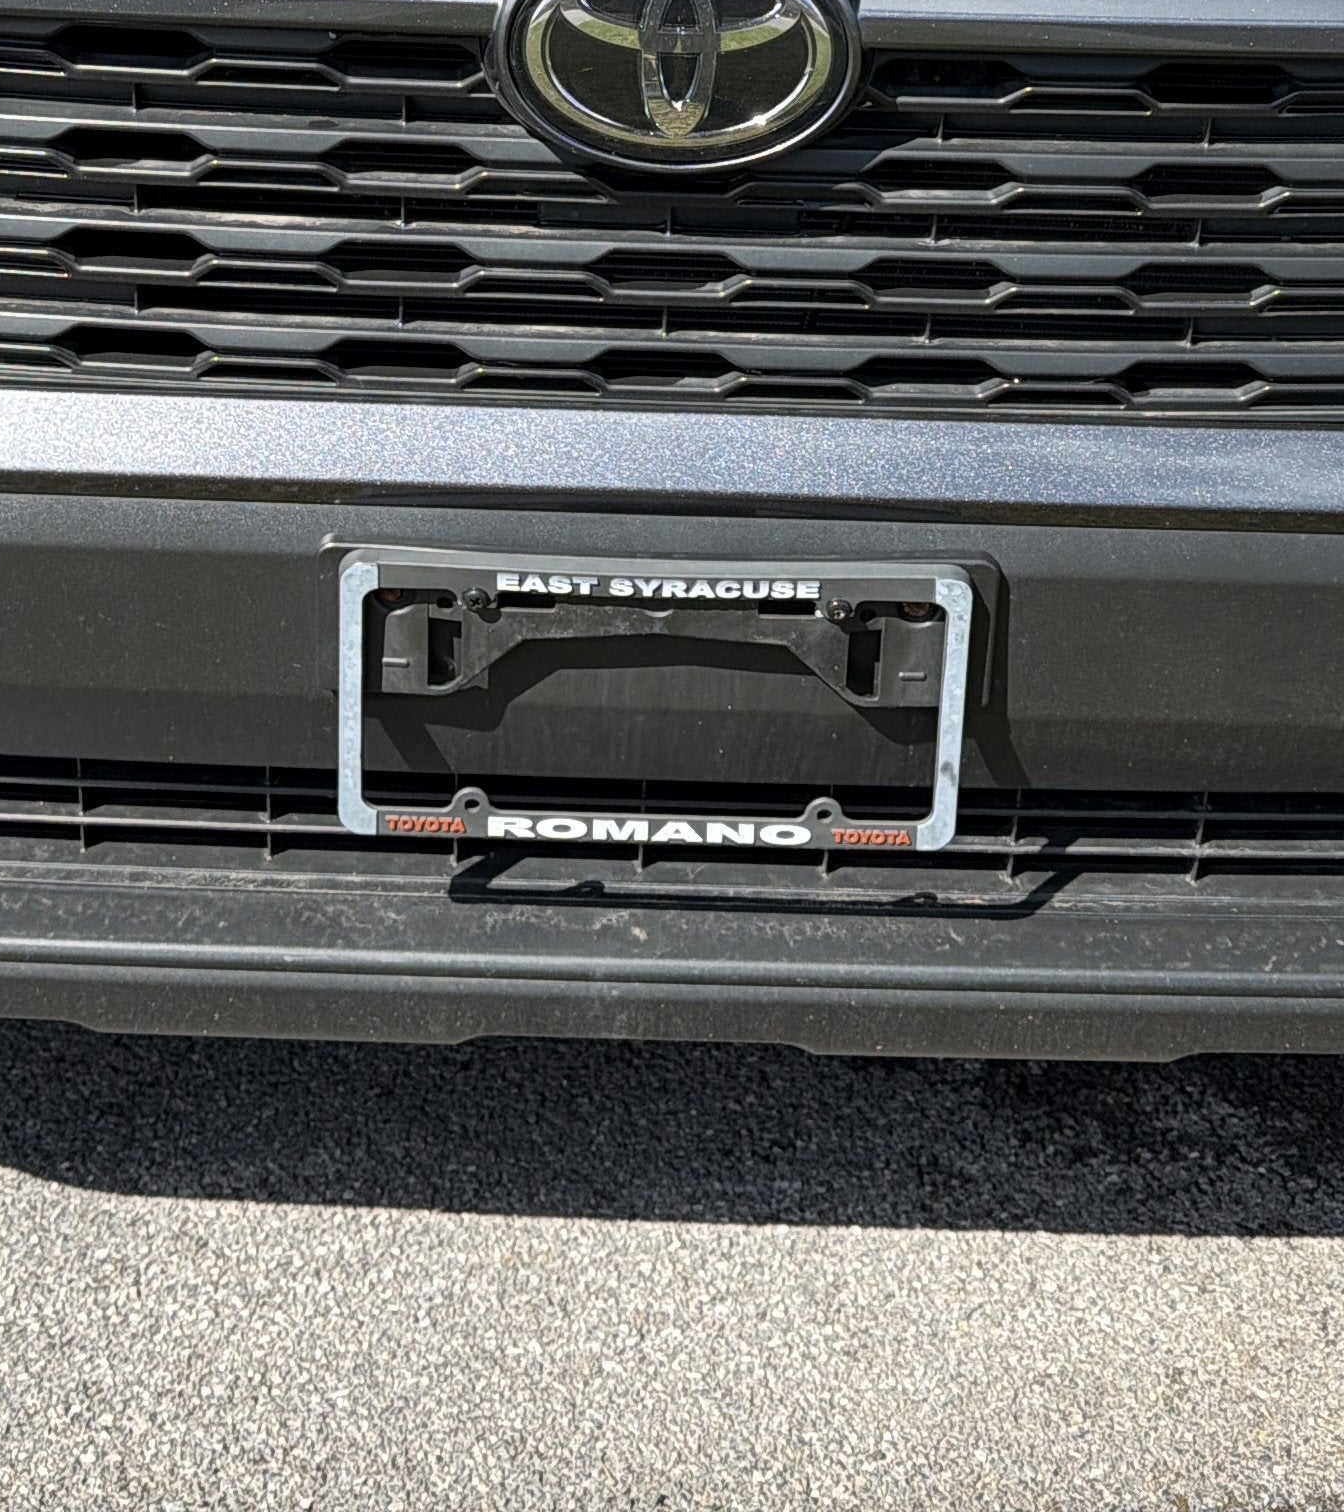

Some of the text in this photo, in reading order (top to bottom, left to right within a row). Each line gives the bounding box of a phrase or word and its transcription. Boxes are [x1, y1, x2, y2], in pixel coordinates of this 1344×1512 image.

[496, 572, 821, 600] EAST SYRACUSE
[385, 814, 912, 847] TOYOTA ROMANO TOYOTA
